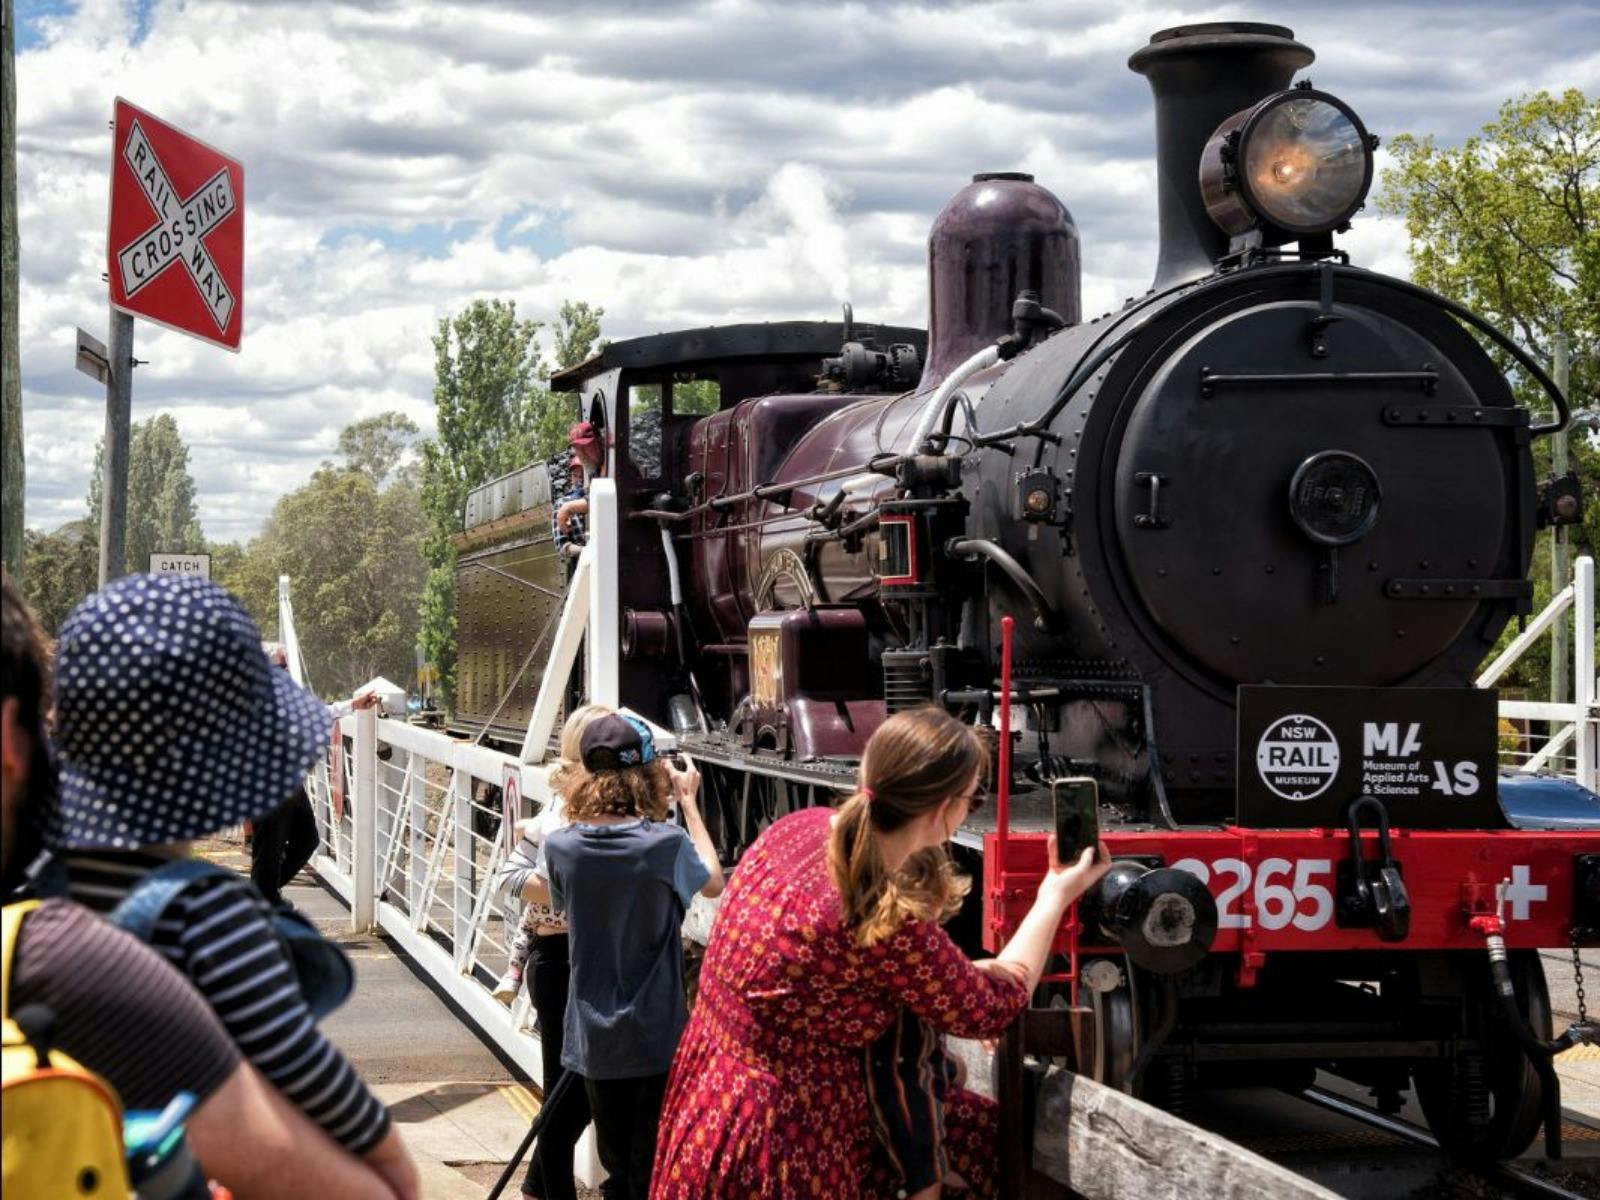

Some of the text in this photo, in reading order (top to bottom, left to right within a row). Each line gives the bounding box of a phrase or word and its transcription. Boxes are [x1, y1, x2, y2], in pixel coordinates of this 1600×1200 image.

[132, 184, 227, 279] CROSSING
[134, 142, 227, 310] RAIL WAY
[161, 561, 200, 571] CATCH
[1281, 726, 1317, 739] NSW
[1268, 746, 1331, 768] RAIL
[1363, 760, 1420, 771] Museum of
[1275, 775, 1320, 785] MUSEUM
[1363, 772, 1430, 784] Applied Arts
[1363, 784, 1420, 794] & Sciences
